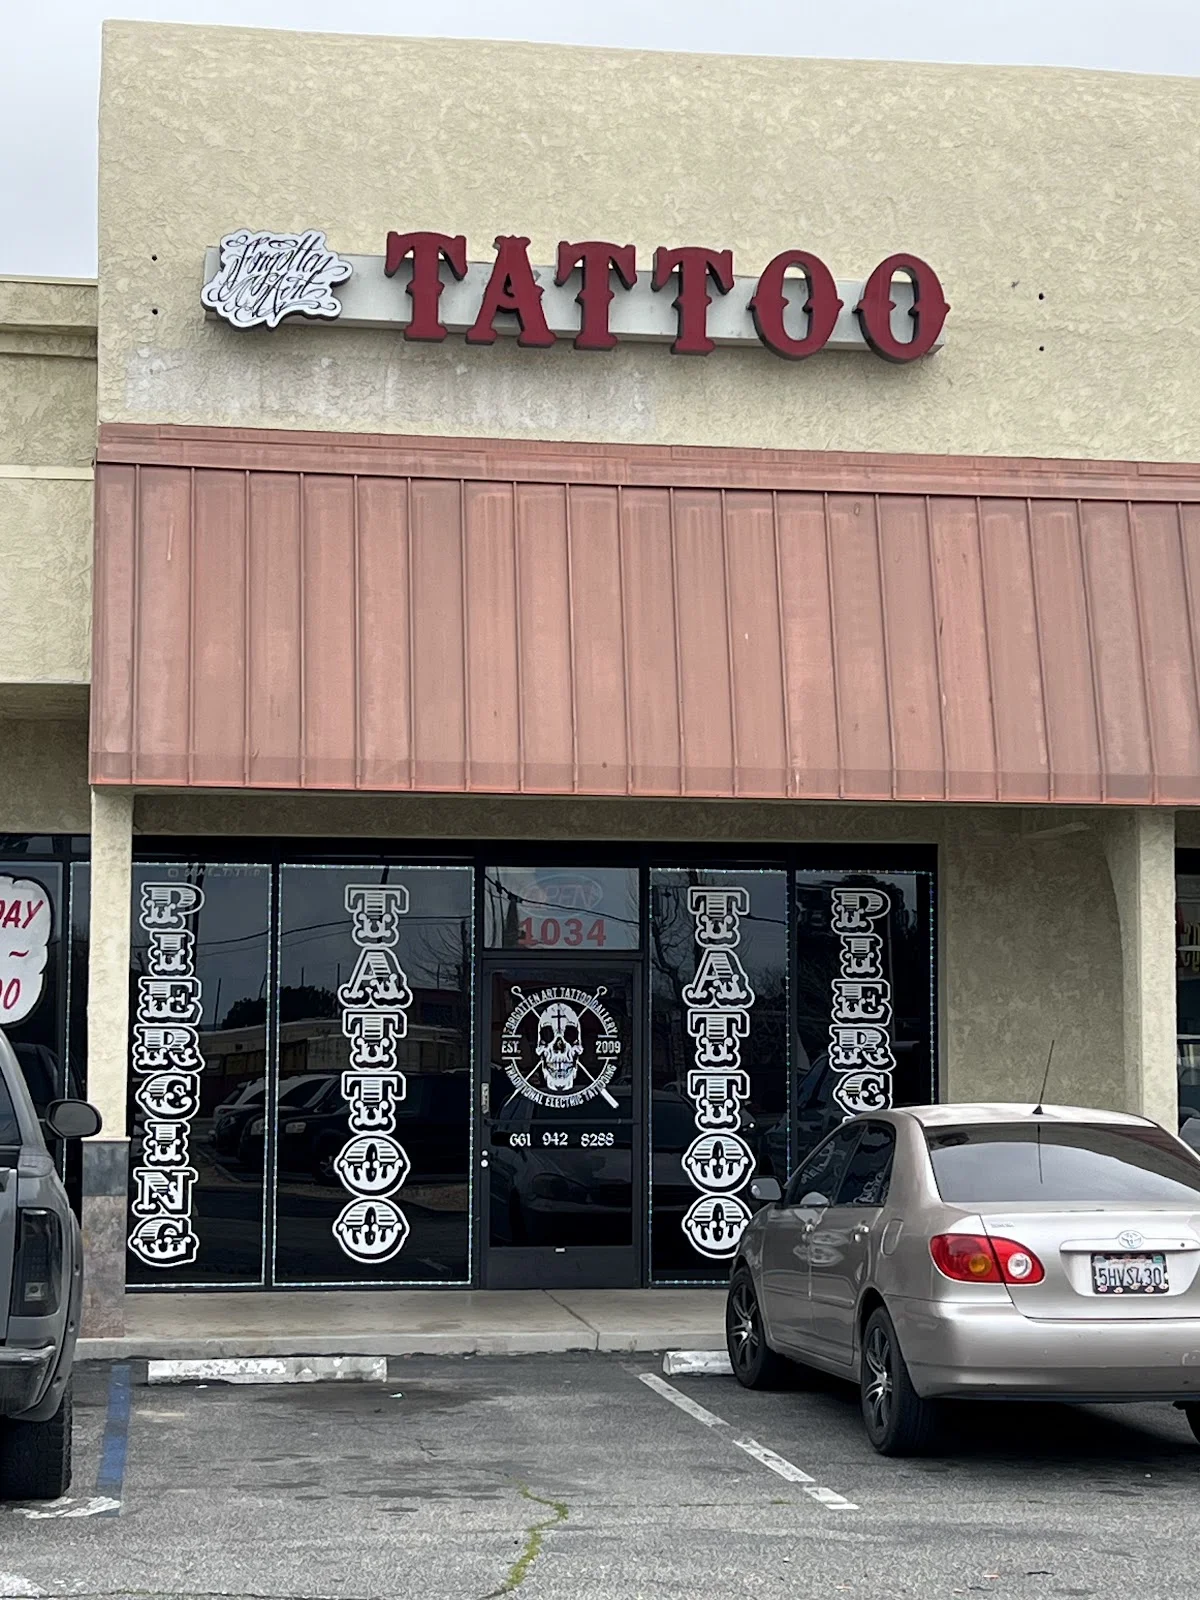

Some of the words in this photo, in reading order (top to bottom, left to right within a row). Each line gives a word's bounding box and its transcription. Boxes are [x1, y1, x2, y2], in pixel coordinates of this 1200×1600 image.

[384, 230, 951, 363] TATTOO
[523, 883, 598, 908] OPEN
[518, 916, 607, 947] 1034
[0, 978, 21, 1010] 0
[502, 992, 541, 1035] FORGOTTEN
[541, 987, 558, 1000] ART
[559, 986, 593, 1006] TATTOO
[589, 999, 619, 1035] GALLERY
[828, 887, 896, 1123] PIERC
[501, 1040, 521, 1054] EST.
[595, 1040, 621, 1054] 2009
[128, 882, 205, 1268] PIERCING
[333, 884, 412, 1264] TATTOO
[504, 1063, 543, 1106] TRADITIONAL
[544, 1094, 584, 1109] ELECTRIC
[582, 1064, 618, 1102] TATTOOING
[681, 886, 757, 1260] TATTOO
[509, 1133, 532, 1147] 661
[541, 1132, 569, 1146] 942
[580, 1132, 615, 1148] 8288
[1099, 1266, 1162, 1287] 5HVS430
